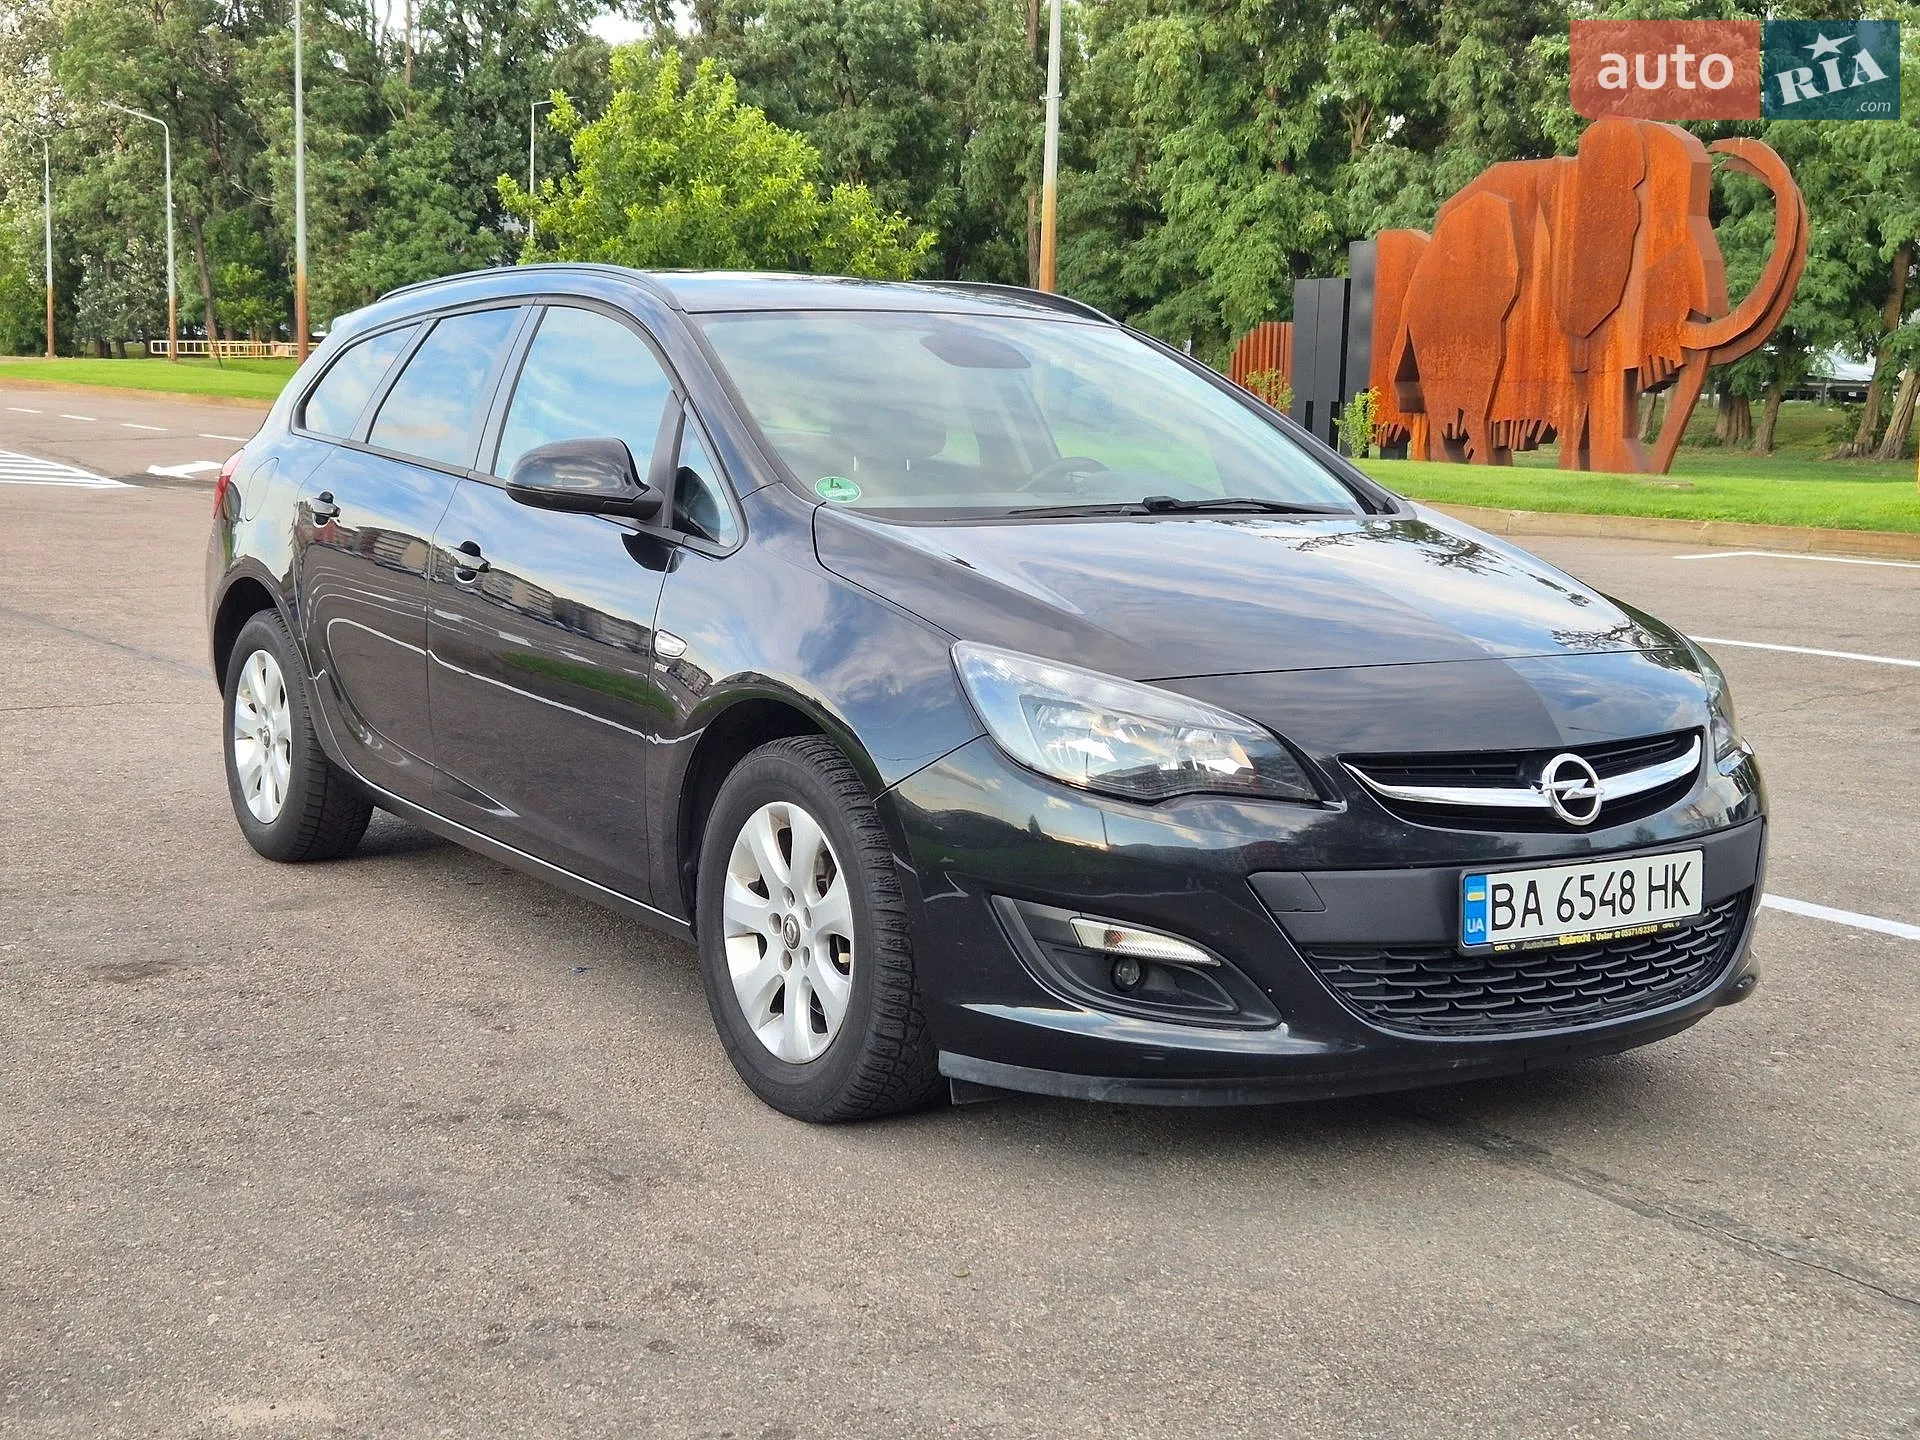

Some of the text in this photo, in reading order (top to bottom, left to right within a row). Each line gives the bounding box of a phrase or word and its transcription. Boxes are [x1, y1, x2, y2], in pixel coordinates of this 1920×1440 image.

[1491, 861, 1691, 931] BA 6548 HK
[1466, 916, 1485, 934] UA
